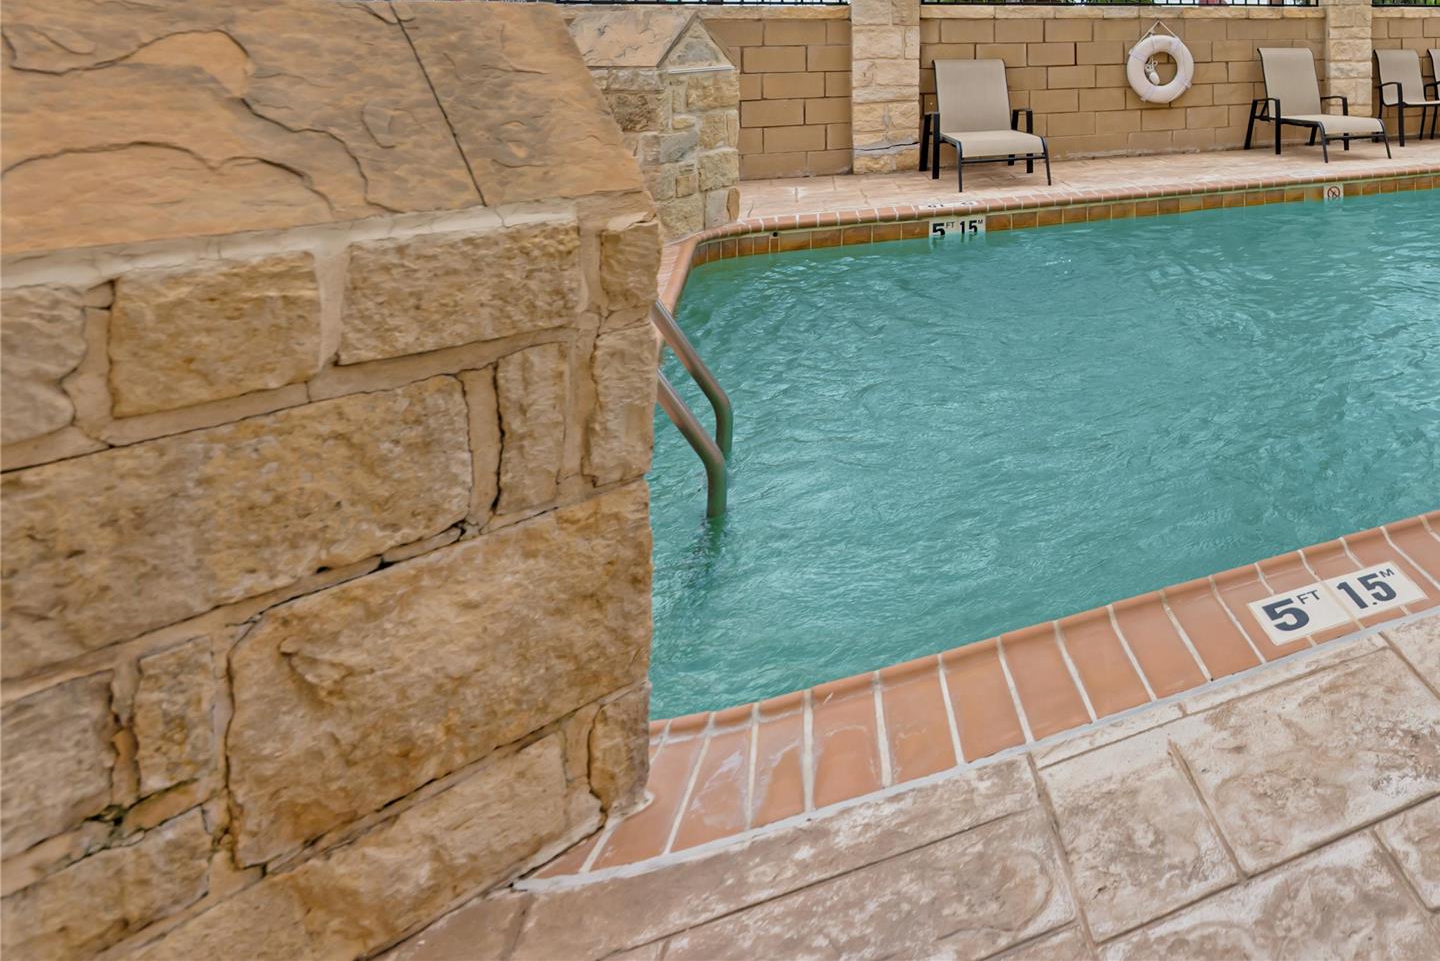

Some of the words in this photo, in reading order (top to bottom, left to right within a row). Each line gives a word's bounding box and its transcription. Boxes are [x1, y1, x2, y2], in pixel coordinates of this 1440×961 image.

[932, 222, 945, 236] 5
[946, 221, 955, 229] FT
[1262, 598, 1310, 632] 5
[1296, 589, 1321, 605] FT
[1379, 568, 1396, 579] M
